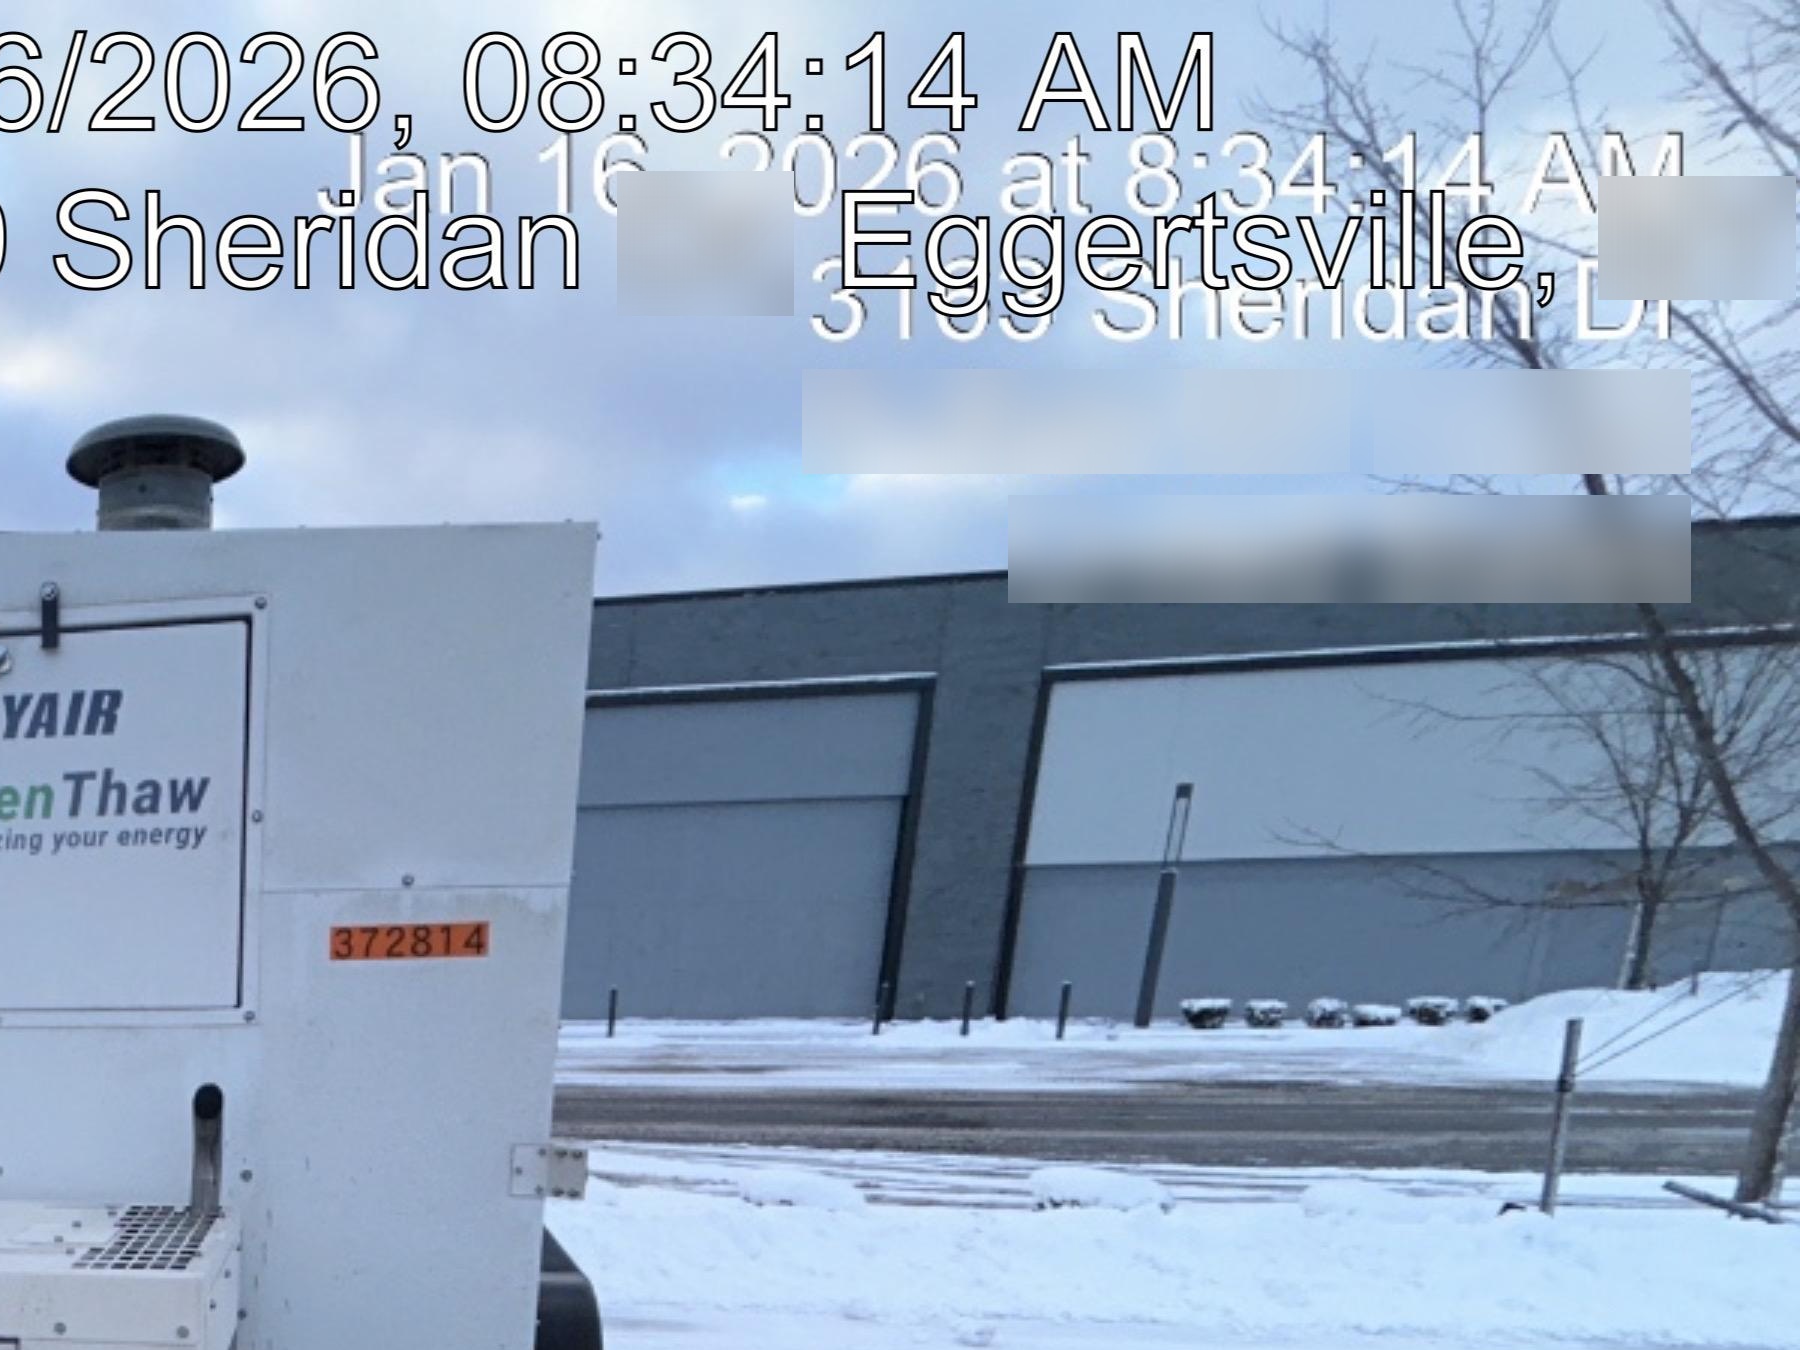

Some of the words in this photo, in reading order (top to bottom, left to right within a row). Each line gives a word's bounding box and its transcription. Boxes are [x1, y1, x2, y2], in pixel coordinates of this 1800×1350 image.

[52, 829, 108, 855] your
[117, 824, 207, 850] energy
[334, 924, 485, 959] 372814
